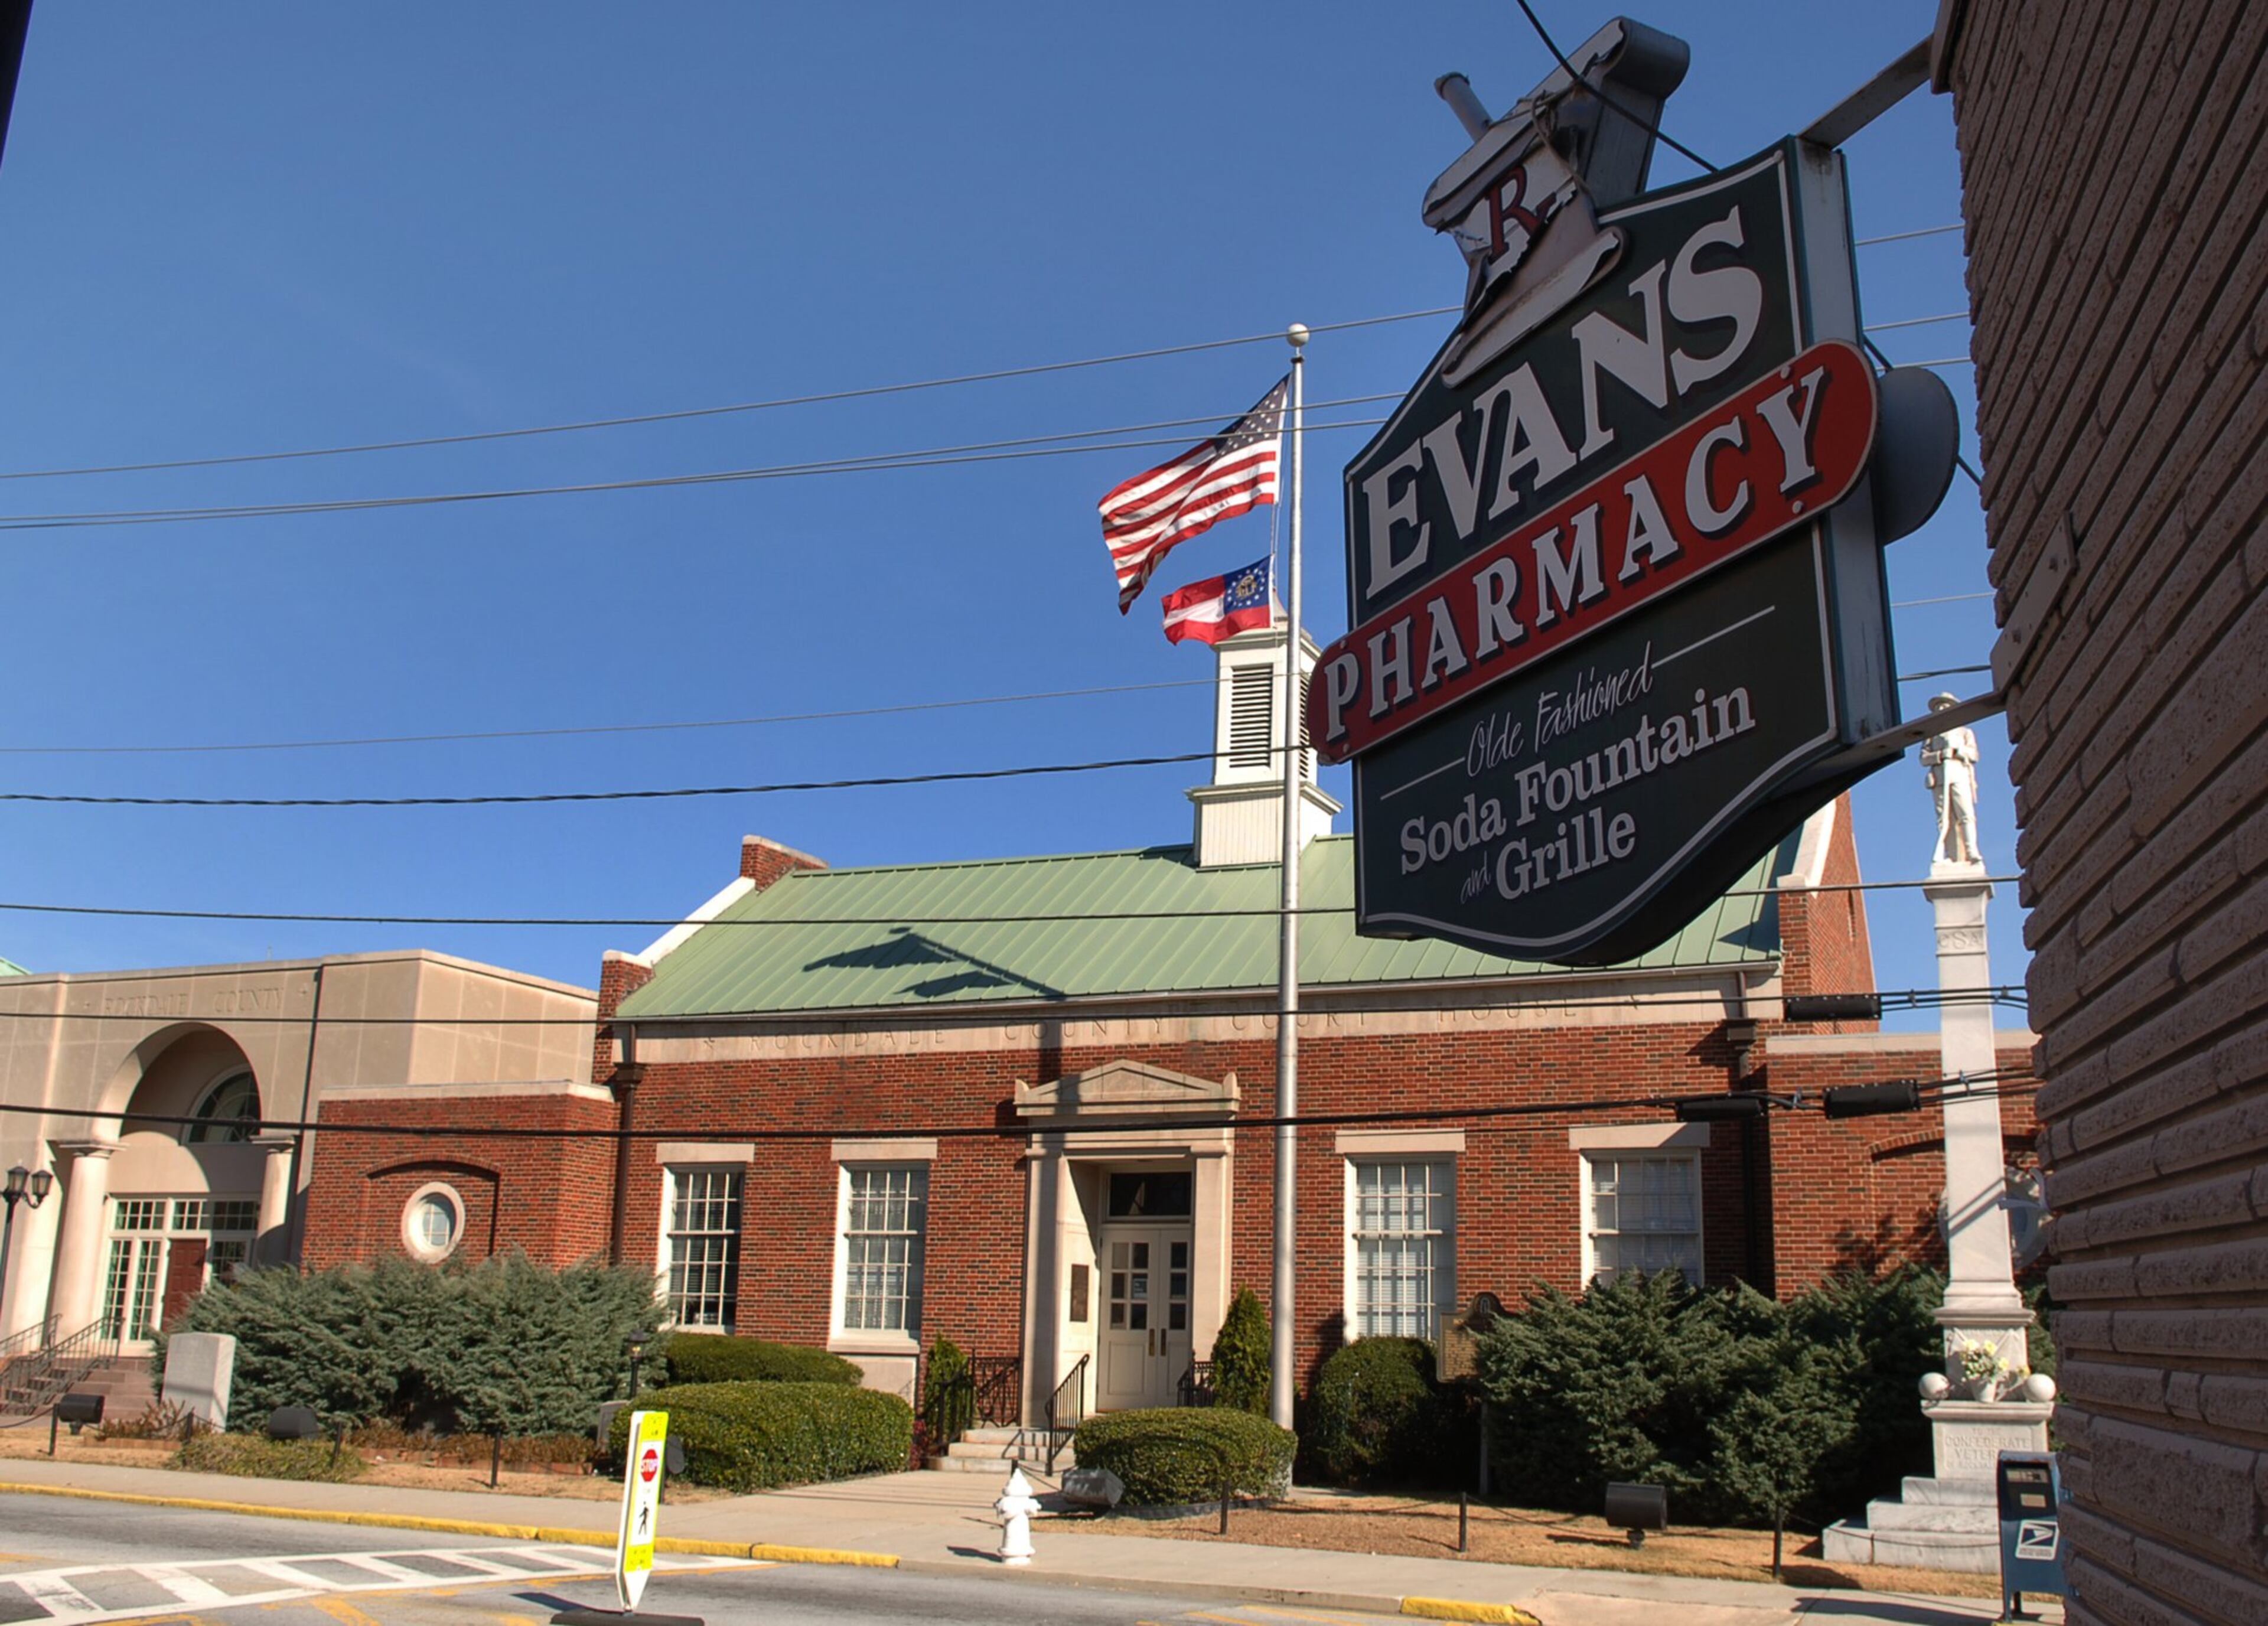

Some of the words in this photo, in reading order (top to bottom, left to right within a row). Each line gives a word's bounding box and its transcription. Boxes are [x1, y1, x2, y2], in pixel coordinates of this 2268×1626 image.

[1362, 204, 1762, 600] EVANS
[1324, 366, 1826, 742] PHARMACY
[1467, 712, 1524, 777] Olde
[1534, 641, 1653, 754] Fashioned
[1400, 793, 1507, 875] Soda
[1514, 686, 1757, 826] Fountain
[1460, 851, 1491, 904] and
[1495, 806, 1636, 900] Grille
[1937, 930, 1983, 950] CSA
[214, 987, 284, 1012] COUNTY
[750, 1025, 944, 1051] ROCKDALE
[1003, 1017, 1163, 1041] COUNTY
[1945, 1436, 2029, 1448] CONFEDERATE
[1954, 1448, 1996, 1460] VETER
[641, 1458, 659, 1472] STOP
